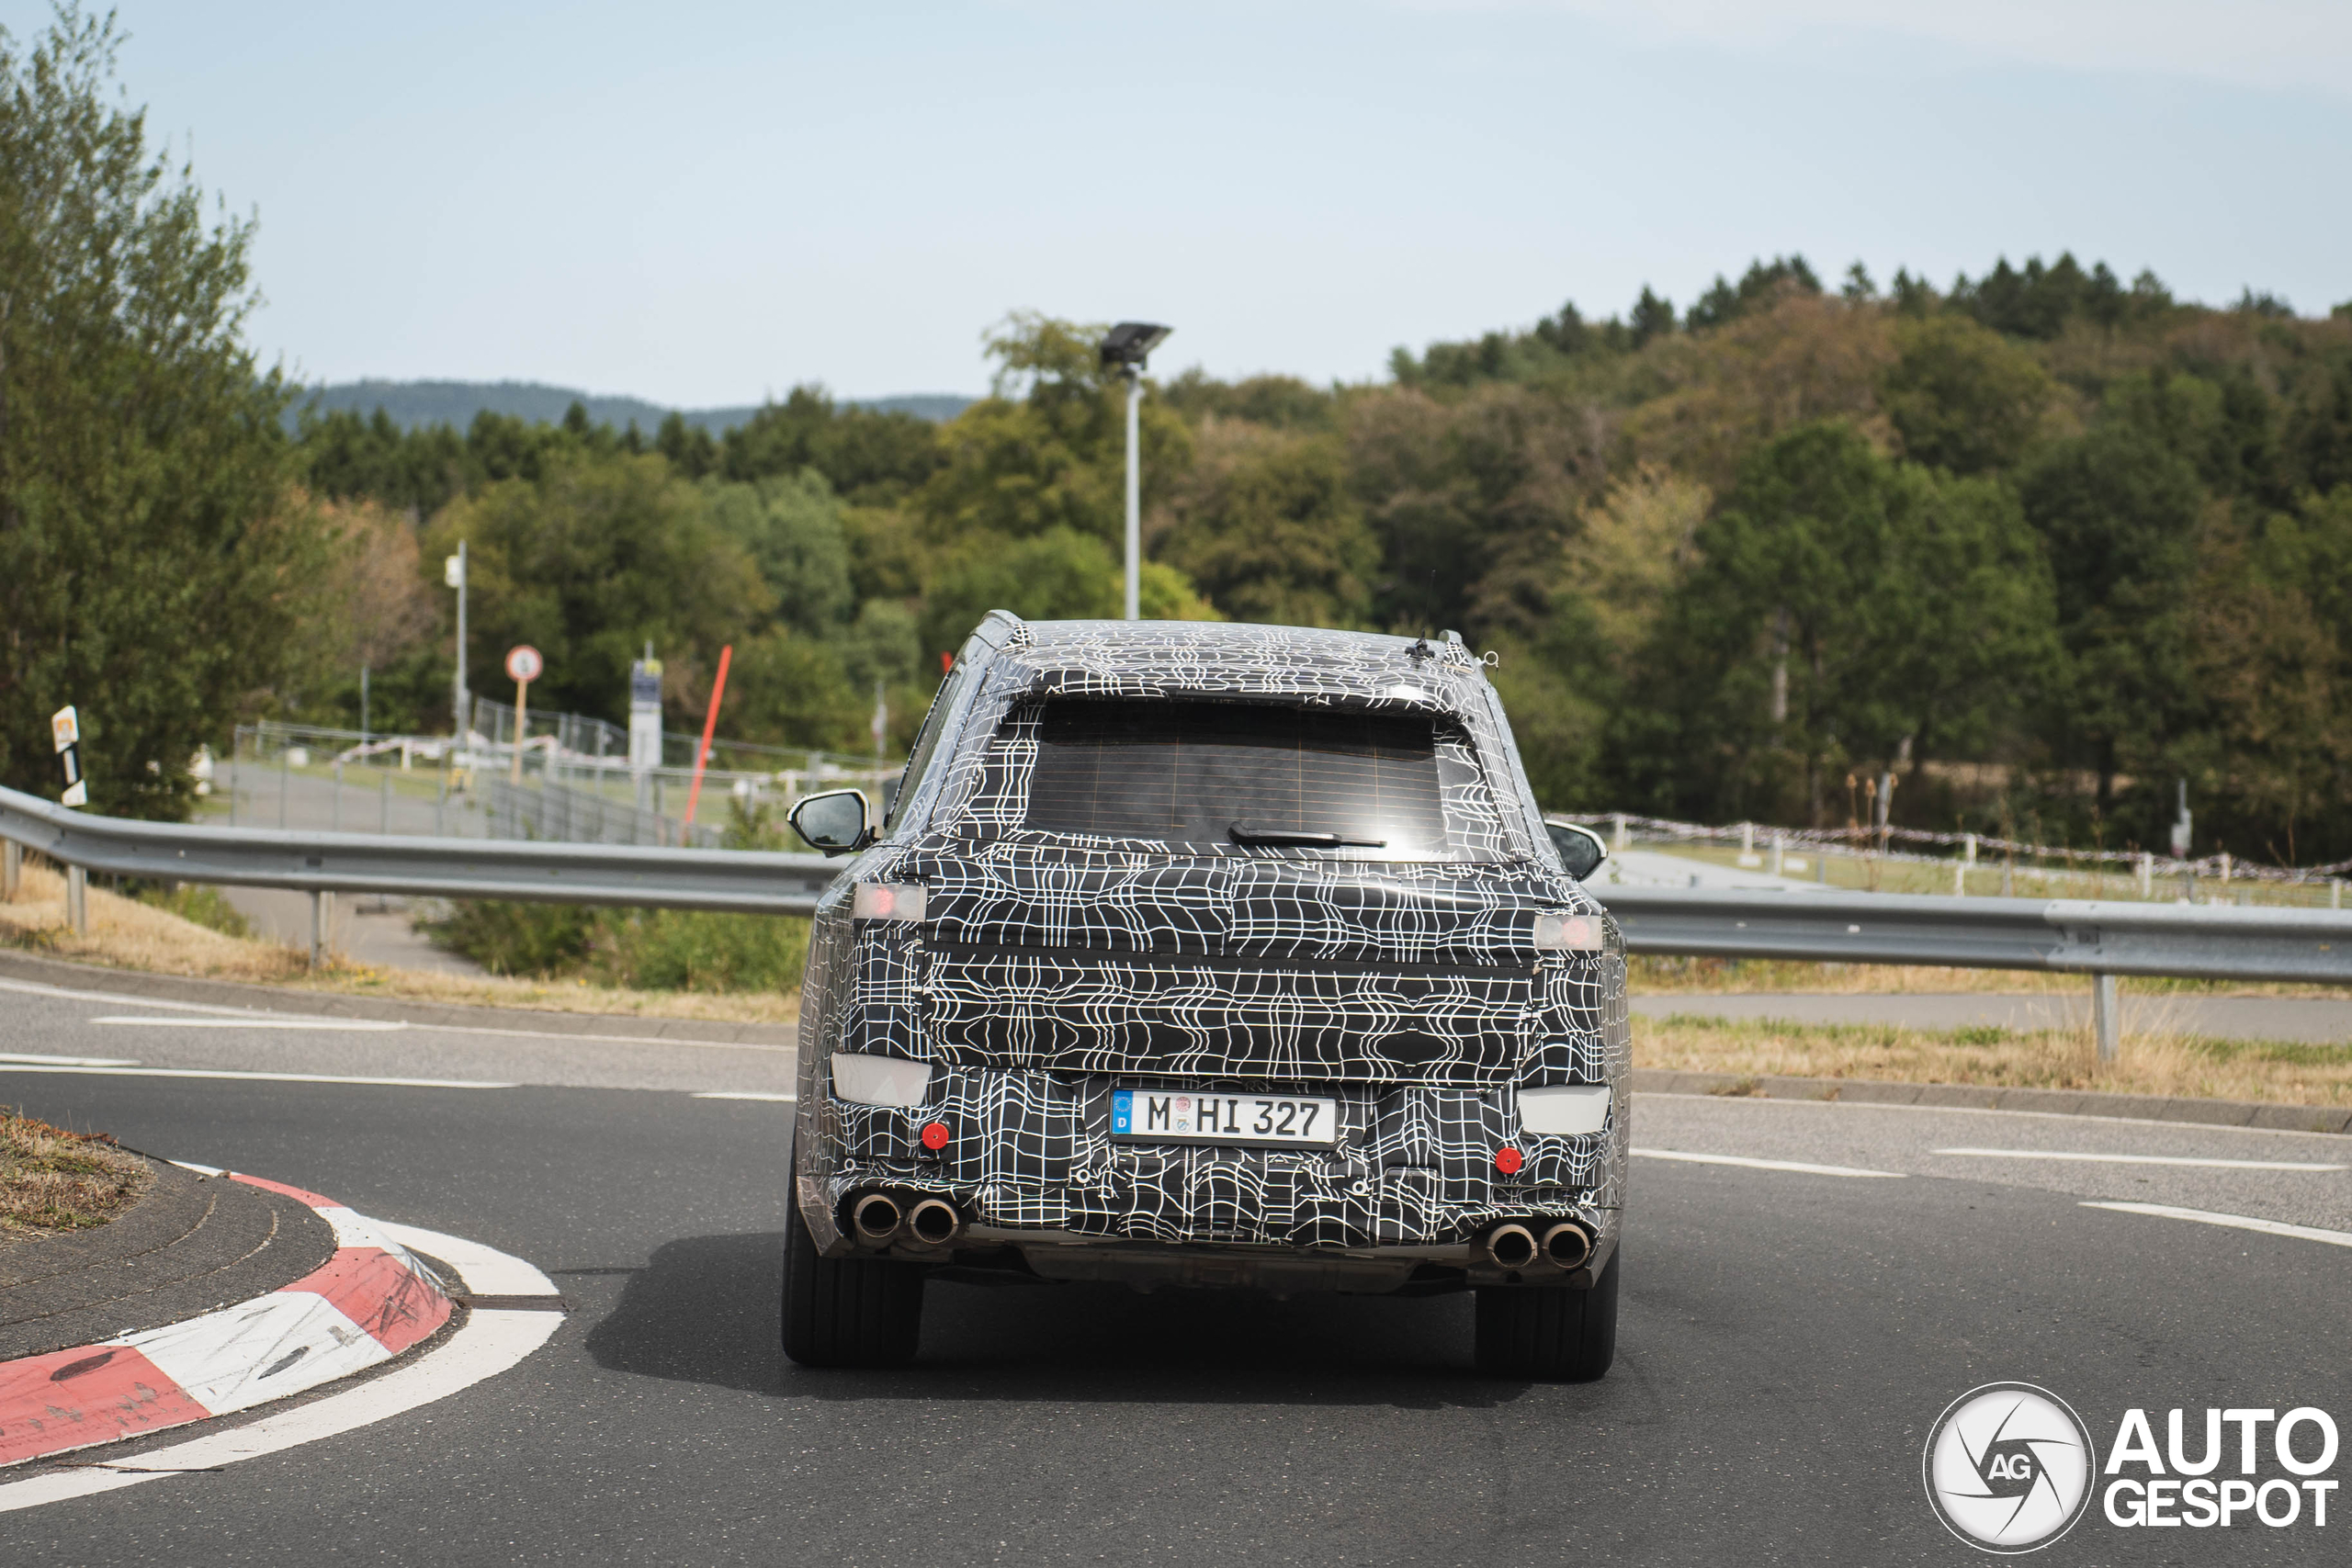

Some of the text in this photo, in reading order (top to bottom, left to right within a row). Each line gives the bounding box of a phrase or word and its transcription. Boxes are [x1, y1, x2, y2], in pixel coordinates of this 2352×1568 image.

[1117, 1118, 1126, 1128] D
[1148, 1097, 1320, 1136] M HI 327
